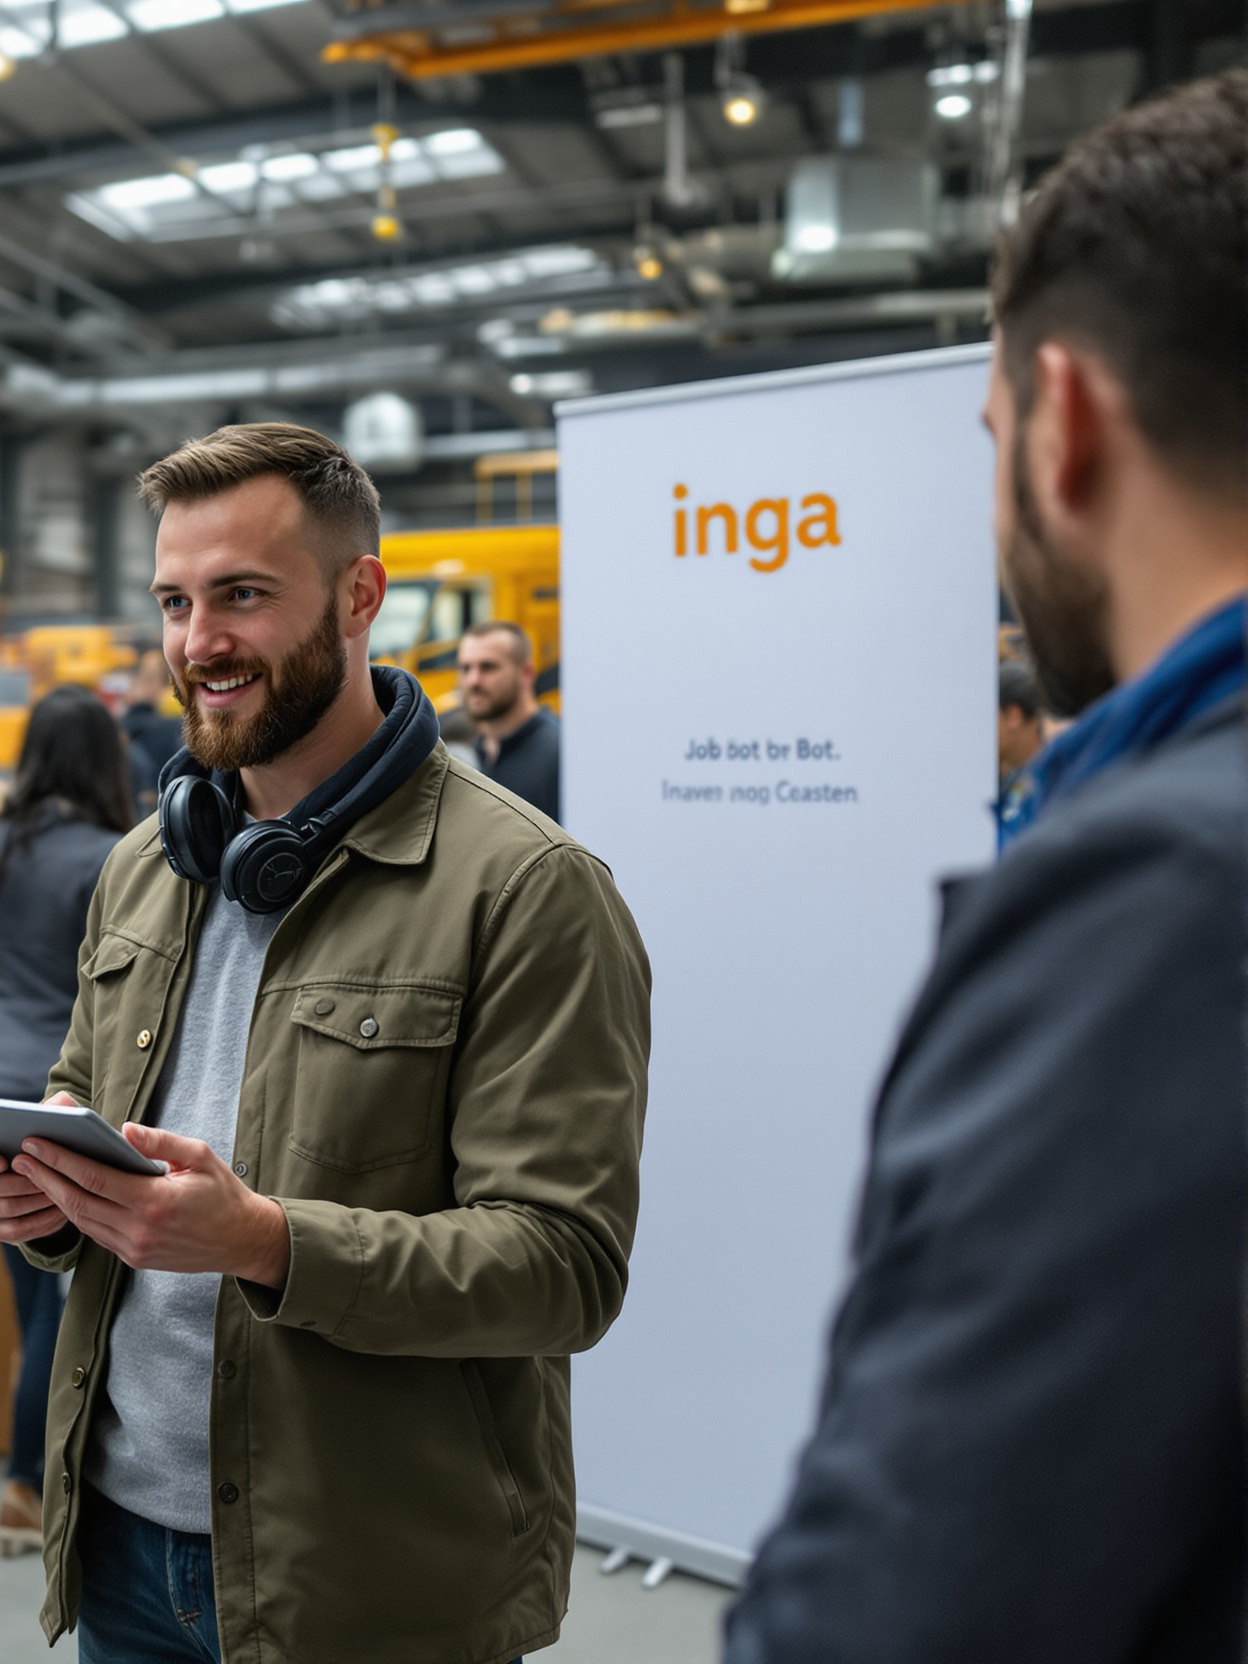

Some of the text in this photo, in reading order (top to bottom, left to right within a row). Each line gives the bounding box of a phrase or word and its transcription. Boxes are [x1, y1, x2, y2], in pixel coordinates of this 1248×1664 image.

[673, 483, 842, 574] inga
[685, 737, 722, 761] Job
[796, 737, 842, 761] Bot.
